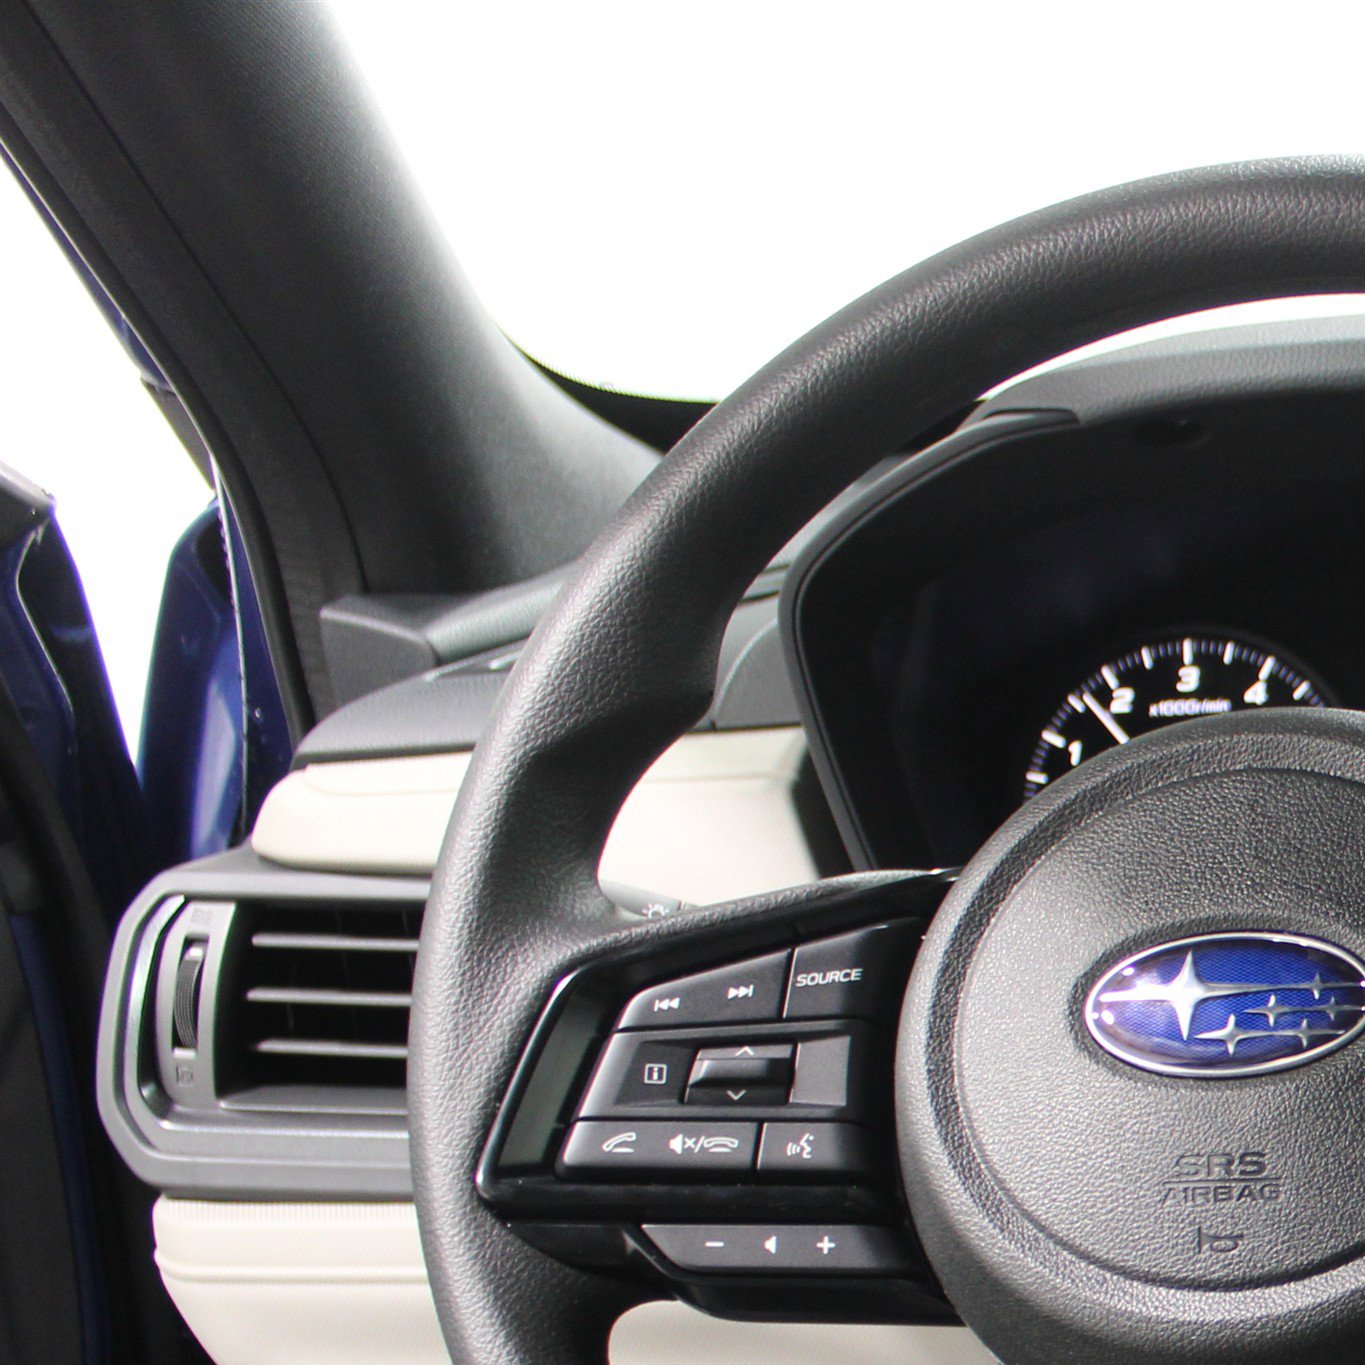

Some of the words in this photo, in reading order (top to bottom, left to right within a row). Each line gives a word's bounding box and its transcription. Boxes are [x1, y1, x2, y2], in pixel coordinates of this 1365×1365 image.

[1176, 665, 1200, 692] 3
[1109, 687, 1135, 714] 2
[1243, 680, 1268, 705] 4
[1068, 740, 1082, 766] 1
[795, 968, 863, 988] SOURCE
[1173, 1153, 1267, 1179] SRS
[1159, 1183, 1281, 1203] AIRBAG
